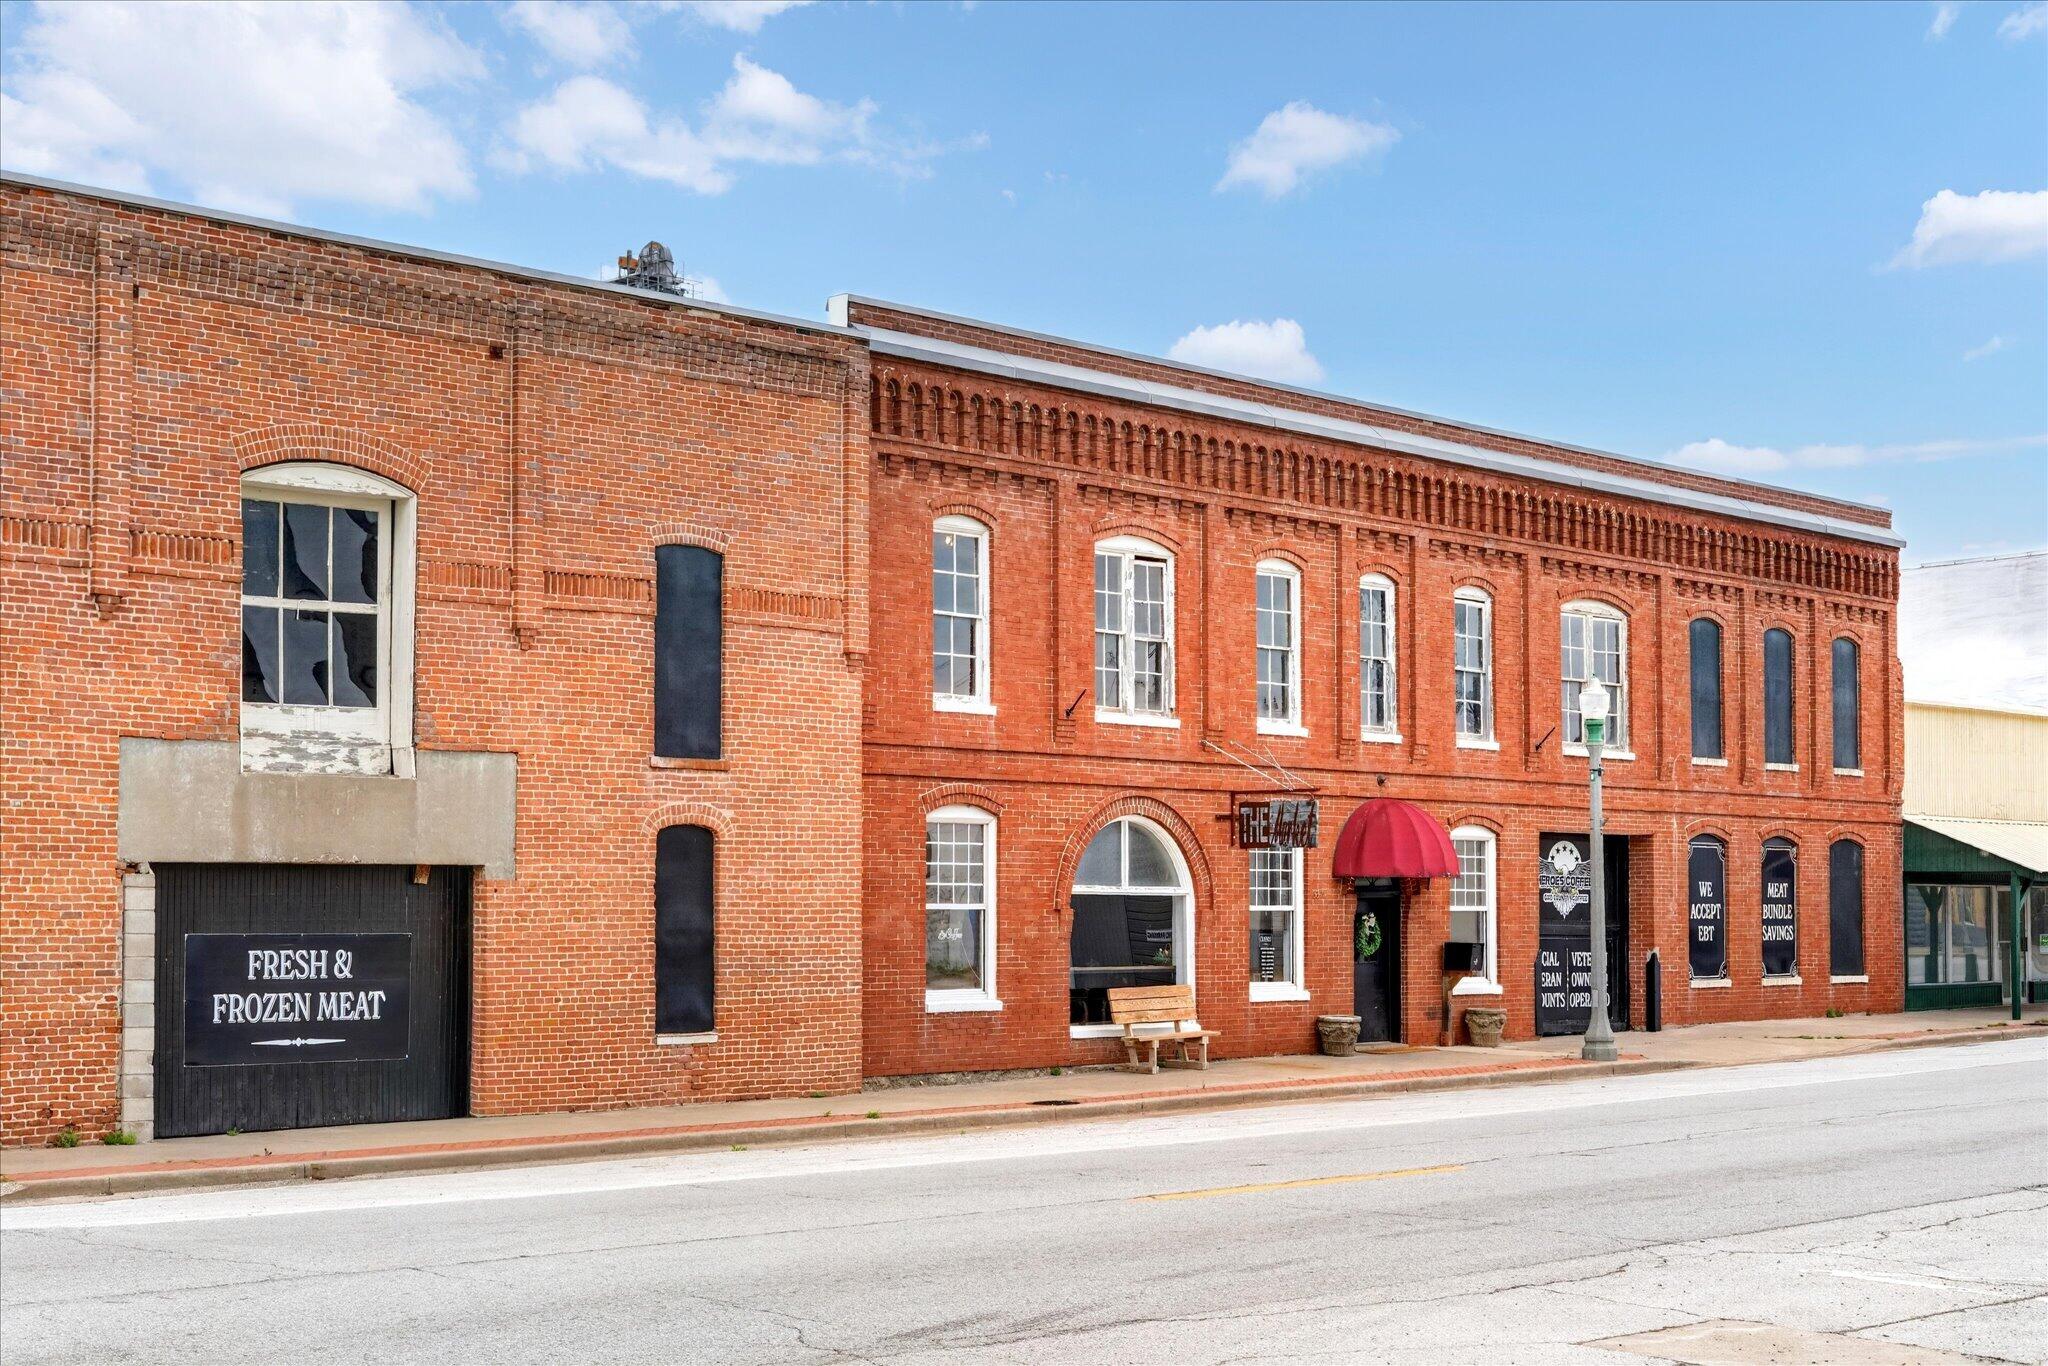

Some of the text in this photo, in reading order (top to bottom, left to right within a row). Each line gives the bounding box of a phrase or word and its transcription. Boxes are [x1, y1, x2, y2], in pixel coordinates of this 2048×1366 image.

[1241, 807, 1268, 843] THE
[1698, 881, 1713, 898] WE
[1767, 882, 1788, 898] MEAT
[1690, 903, 1721, 920] ACCEPT
[1763, 904, 1793, 920] BUNDLE
[1698, 925, 1715, 942] EBT
[1762, 925, 1794, 941] SAVINGS
[247, 948, 354, 981] FRESH &
[1541, 951, 1560, 967] CIAL
[1541, 972, 1562, 987] ERAN
[1571, 972, 1592, 987] OWN
[212, 990, 386, 1025] FROZEN MEAT
